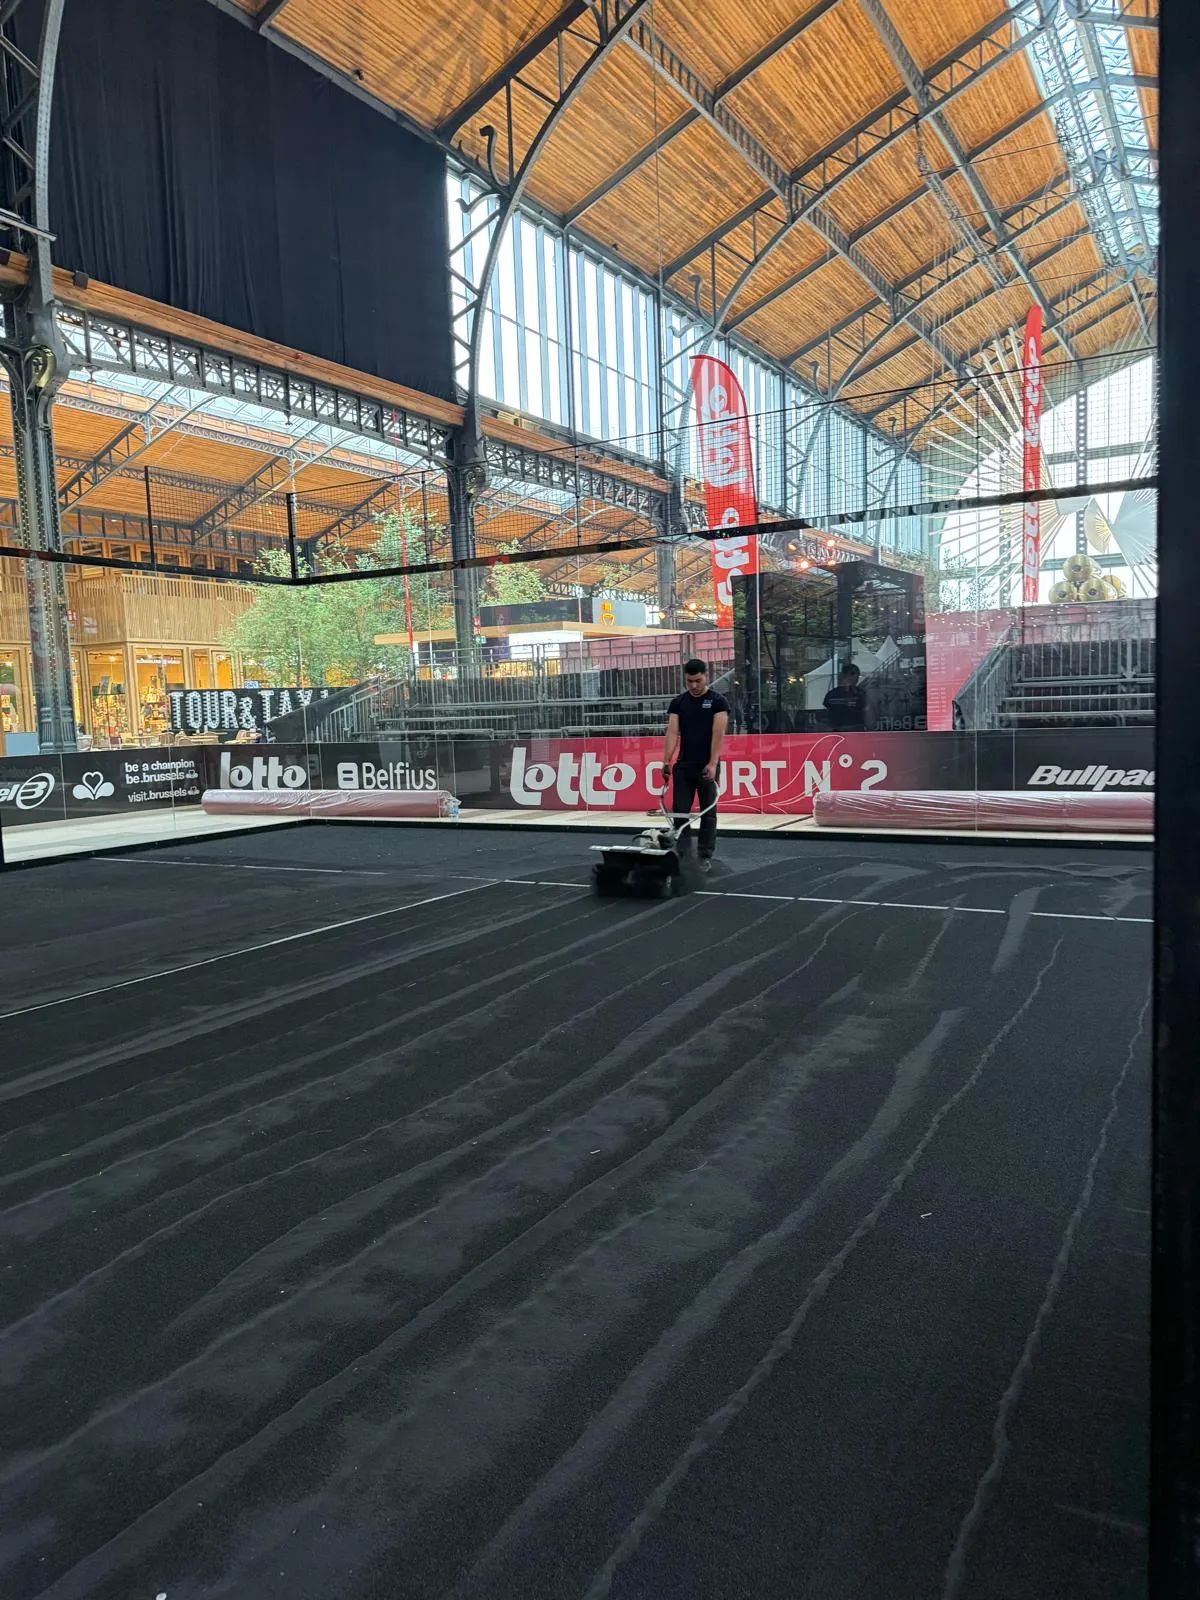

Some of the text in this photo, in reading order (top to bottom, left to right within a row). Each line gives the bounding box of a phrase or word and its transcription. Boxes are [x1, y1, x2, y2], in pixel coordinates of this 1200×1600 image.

[125, 759, 195, 773] be a champion
[220, 752, 307, 789] lotto
[362, 762, 437, 790] Belfius
[510, 747, 636, 805] lotto
[646, 760, 787, 797] CRT
[126, 771, 185, 784] be.brussels
[128, 788, 187, 802] visit.brussels
